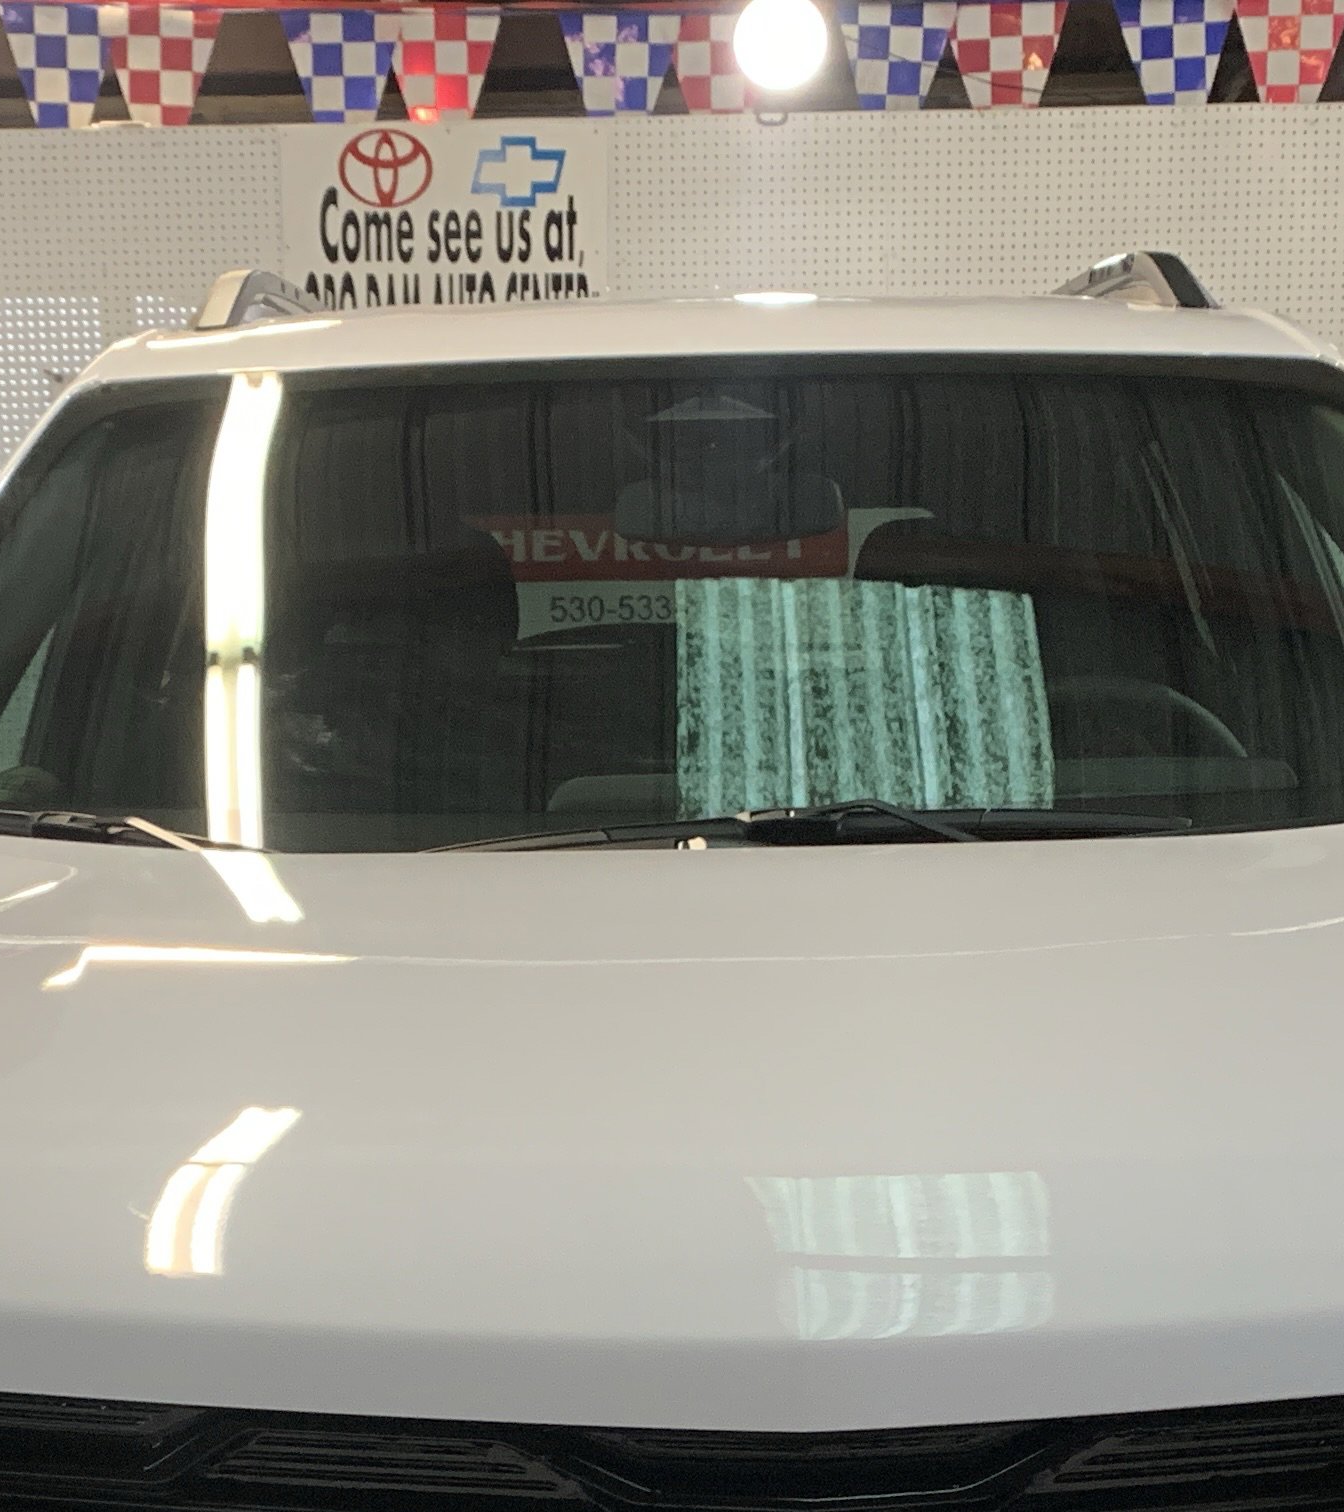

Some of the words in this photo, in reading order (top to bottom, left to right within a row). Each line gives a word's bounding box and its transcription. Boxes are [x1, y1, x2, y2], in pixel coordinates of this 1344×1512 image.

[319, 185, 414, 264] Come
[428, 208, 482, 263] see
[495, 208, 532, 263] us
